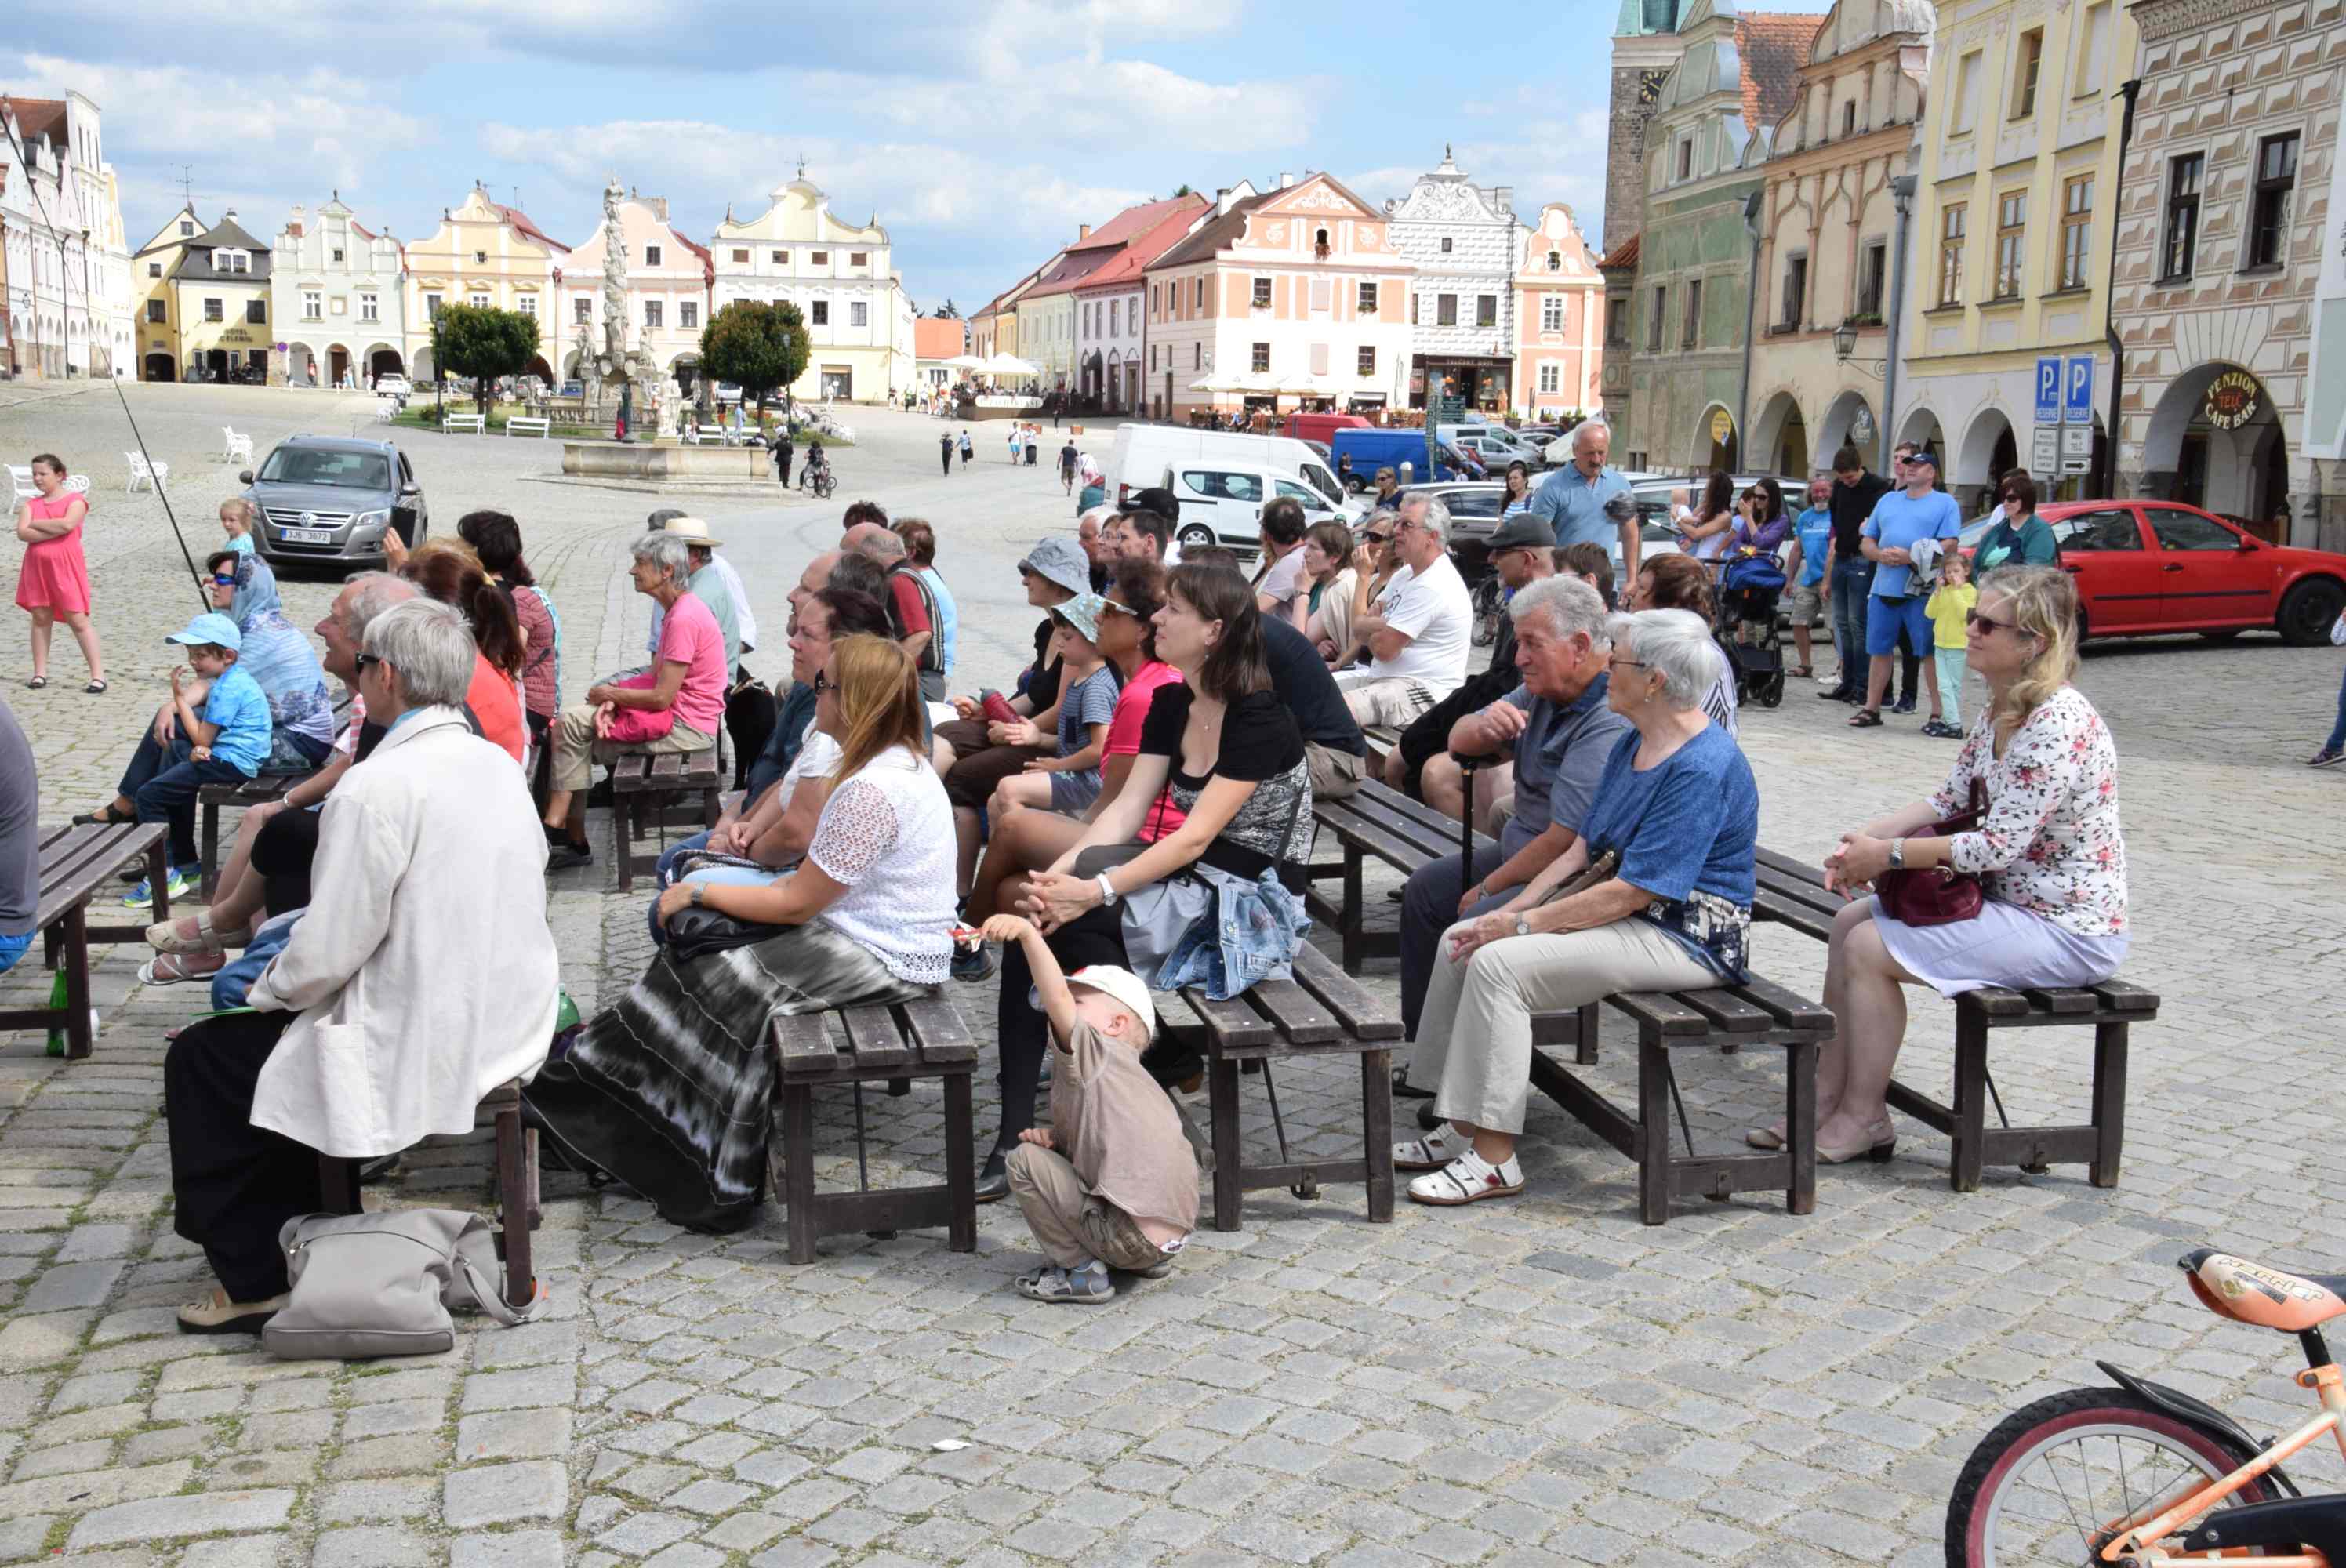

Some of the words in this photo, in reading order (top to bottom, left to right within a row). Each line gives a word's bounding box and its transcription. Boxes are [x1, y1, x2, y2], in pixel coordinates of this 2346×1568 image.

[2042, 365, 2054, 401] P
[2072, 364, 2086, 401] P
[2207, 372, 2257, 400] PENZION
[2205, 402, 2232, 430] CAFE
[2233, 401, 2257, 429] BAR
